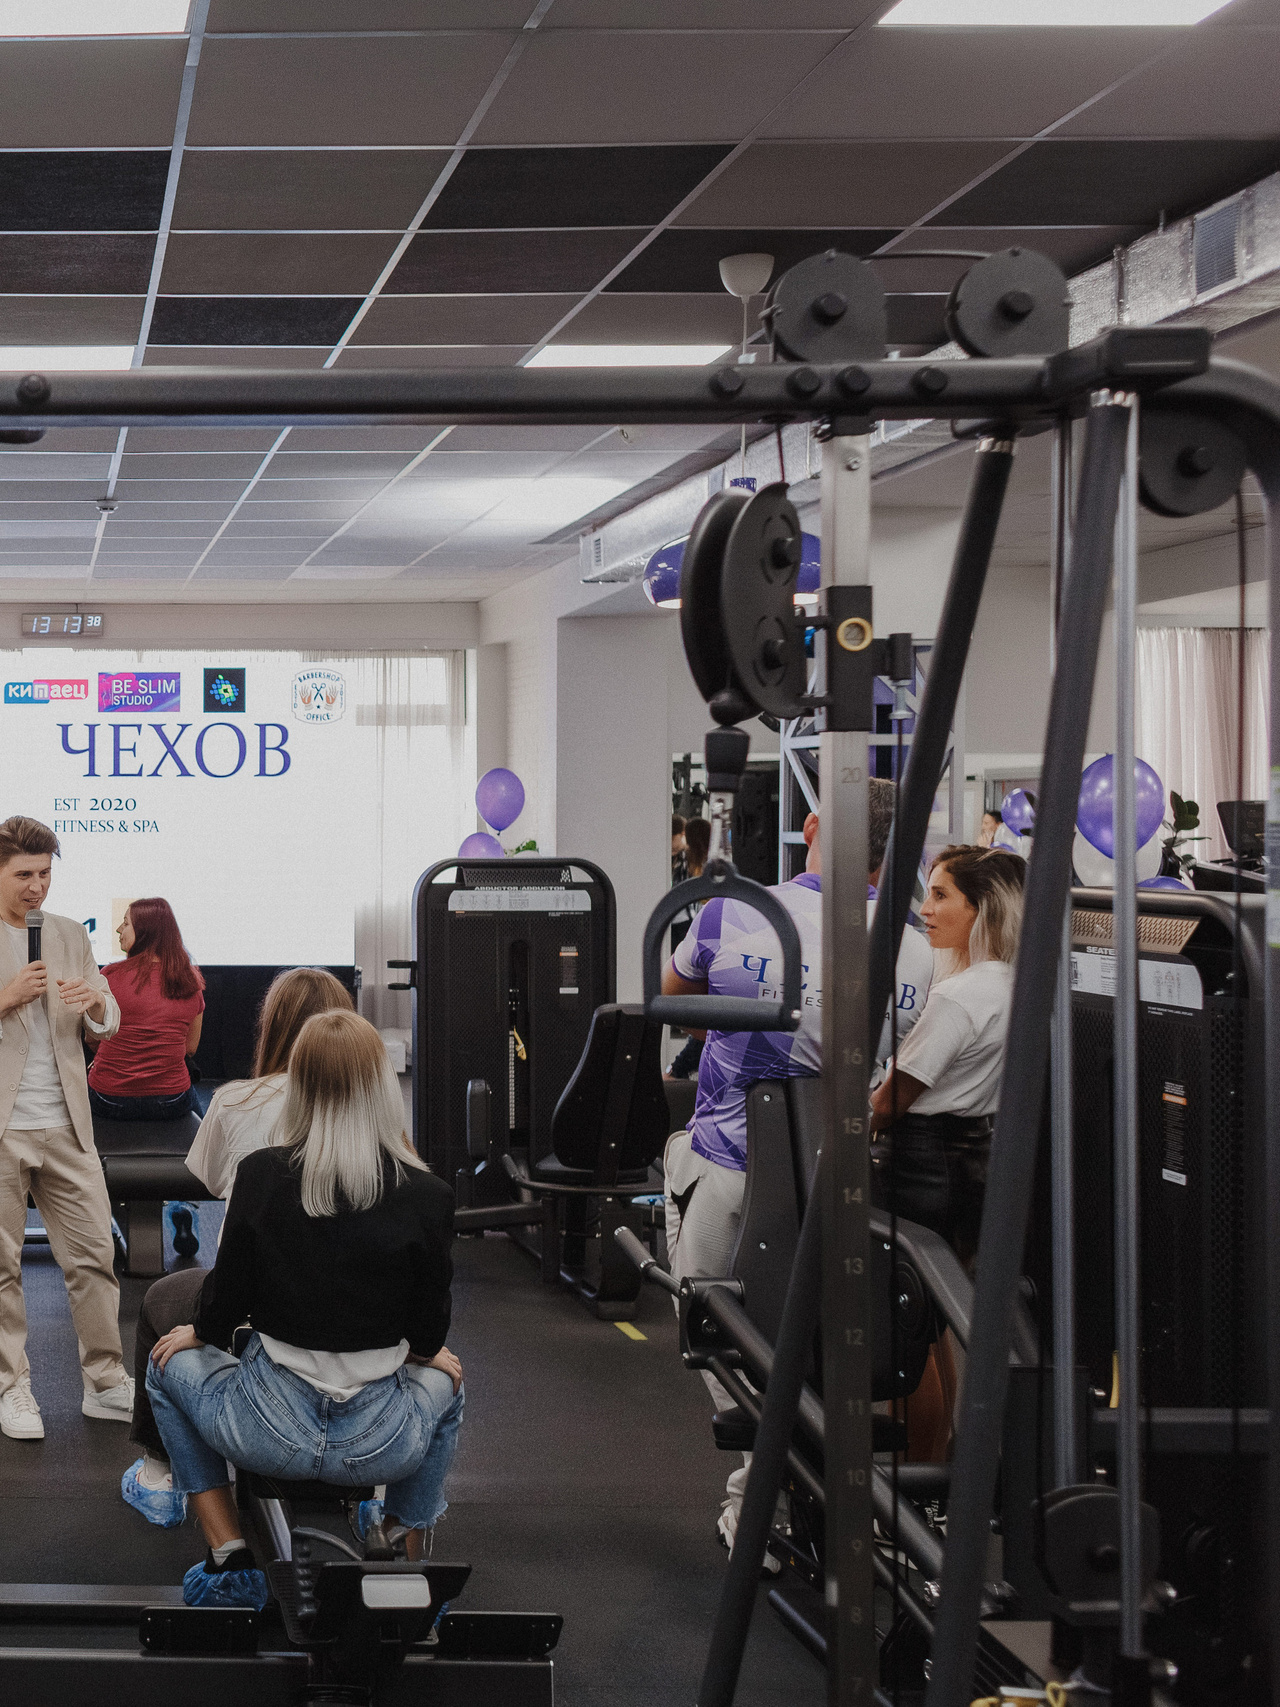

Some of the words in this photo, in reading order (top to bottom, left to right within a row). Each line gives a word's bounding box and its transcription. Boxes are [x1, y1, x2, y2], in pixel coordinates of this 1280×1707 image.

[32, 616, 51, 634] 13
[63, 616, 82, 634] 13
[86, 615, 101, 627] 38
[113, 679, 133, 694] BE
[138, 679, 176, 694] SLIM
[113, 695, 153, 706] STUDIO
[305, 712, 331, 721] OFFICE
[56, 722, 292, 778] ЧЕХОВ
[841, 766, 862, 784] 20
[53, 798, 81, 811] EST
[89, 798, 137, 811] 2020
[53, 820, 114, 833] FITNESS
[118, 820, 129, 833] &
[133, 820, 160, 833] SPA
[1086, 946, 1116, 956] SEATE
[842, 1048, 863, 1065] 16
[842, 1117, 863, 1134] 15
[842, 1187, 863, 1204] 14
[843, 1258, 864, 1275] 13
[844, 1328, 864, 1346] 12
[845, 1399, 865, 1416] 11
[846, 1469, 866, 1486] 10
